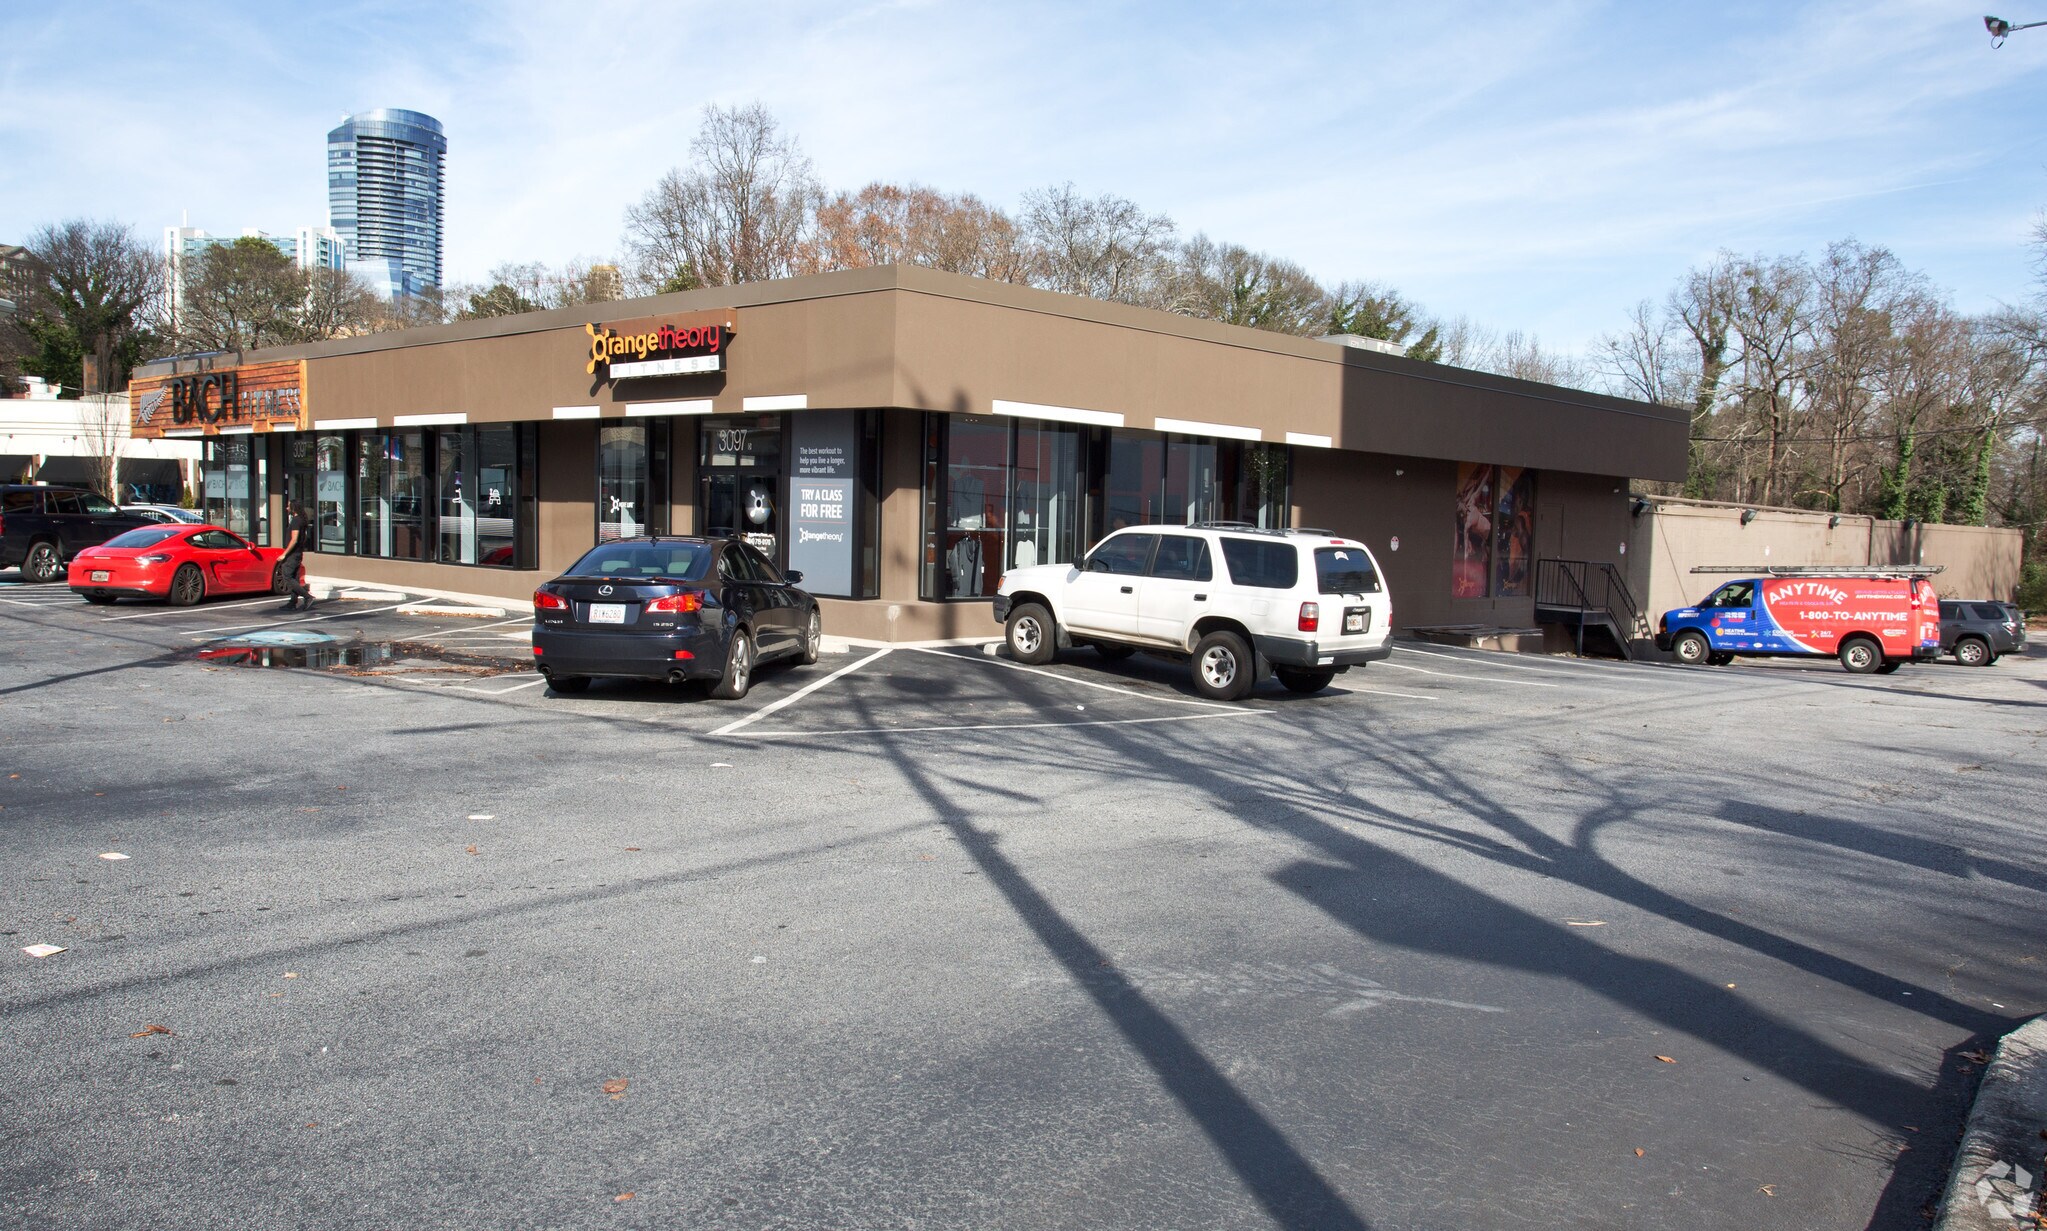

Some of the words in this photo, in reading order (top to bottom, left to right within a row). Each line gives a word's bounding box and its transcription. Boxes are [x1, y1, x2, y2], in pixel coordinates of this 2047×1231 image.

[613, 357, 718, 374] FITNESS
[172, 372, 238, 425] BACH
[241, 388, 300, 419] FITNESS
[719, 429, 747, 451] 3097
[800, 447, 808, 455] The
[808, 447, 818, 455] best
[800, 457, 809, 465] help
[809, 458, 817, 466] you
[830, 457, 845, 466] longer,
[811, 466, 826, 474] vibrant
[827, 466, 835, 474] life.
[801, 489, 814, 500] TRY
[815, 489, 820, 500] A
[821, 489, 842, 501] CLASS
[801, 503, 818, 517] FOR
[820, 504, 842, 518] FREE
[1769, 583, 1848, 606] ANYTIME
[1799, 611, 1907, 621] 1-800-TO-ANYTIME
